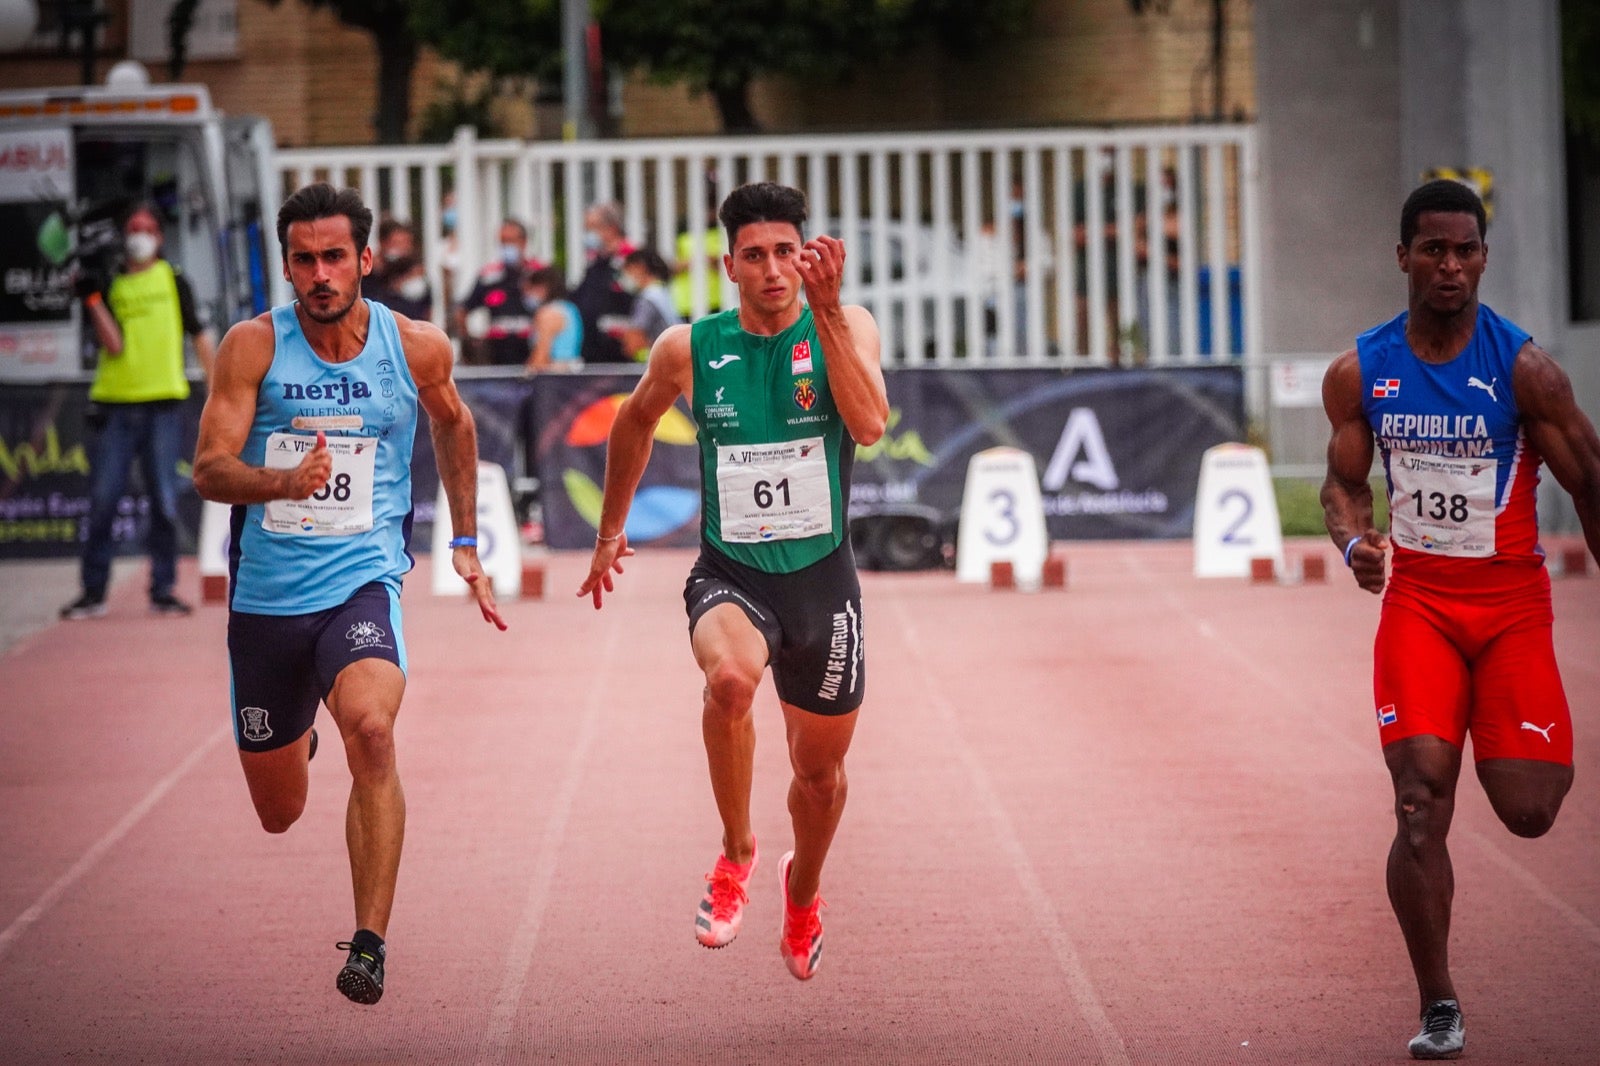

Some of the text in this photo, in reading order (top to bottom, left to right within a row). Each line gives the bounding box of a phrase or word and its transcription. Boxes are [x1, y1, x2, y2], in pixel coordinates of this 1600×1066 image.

[282, 376, 372, 405] nerja
[296, 407, 361, 417] ATLETISMO
[786, 415, 820, 425] VILLARREAL
[1380, 413, 1488, 438] REPUBLICA
[294, 441, 305, 452] VI
[741, 451, 752, 463] VI
[1381, 437, 1494, 457] DOMINICANA
[1411, 458, 1420, 471] VI
[753, 477, 791, 509] 61
[984, 488, 1020, 546] 3
[1217, 488, 1255, 545] 2
[1411, 489, 1469, 523] 138
[817, 612, 848, 700] PLAYAS DE CASTELLON
